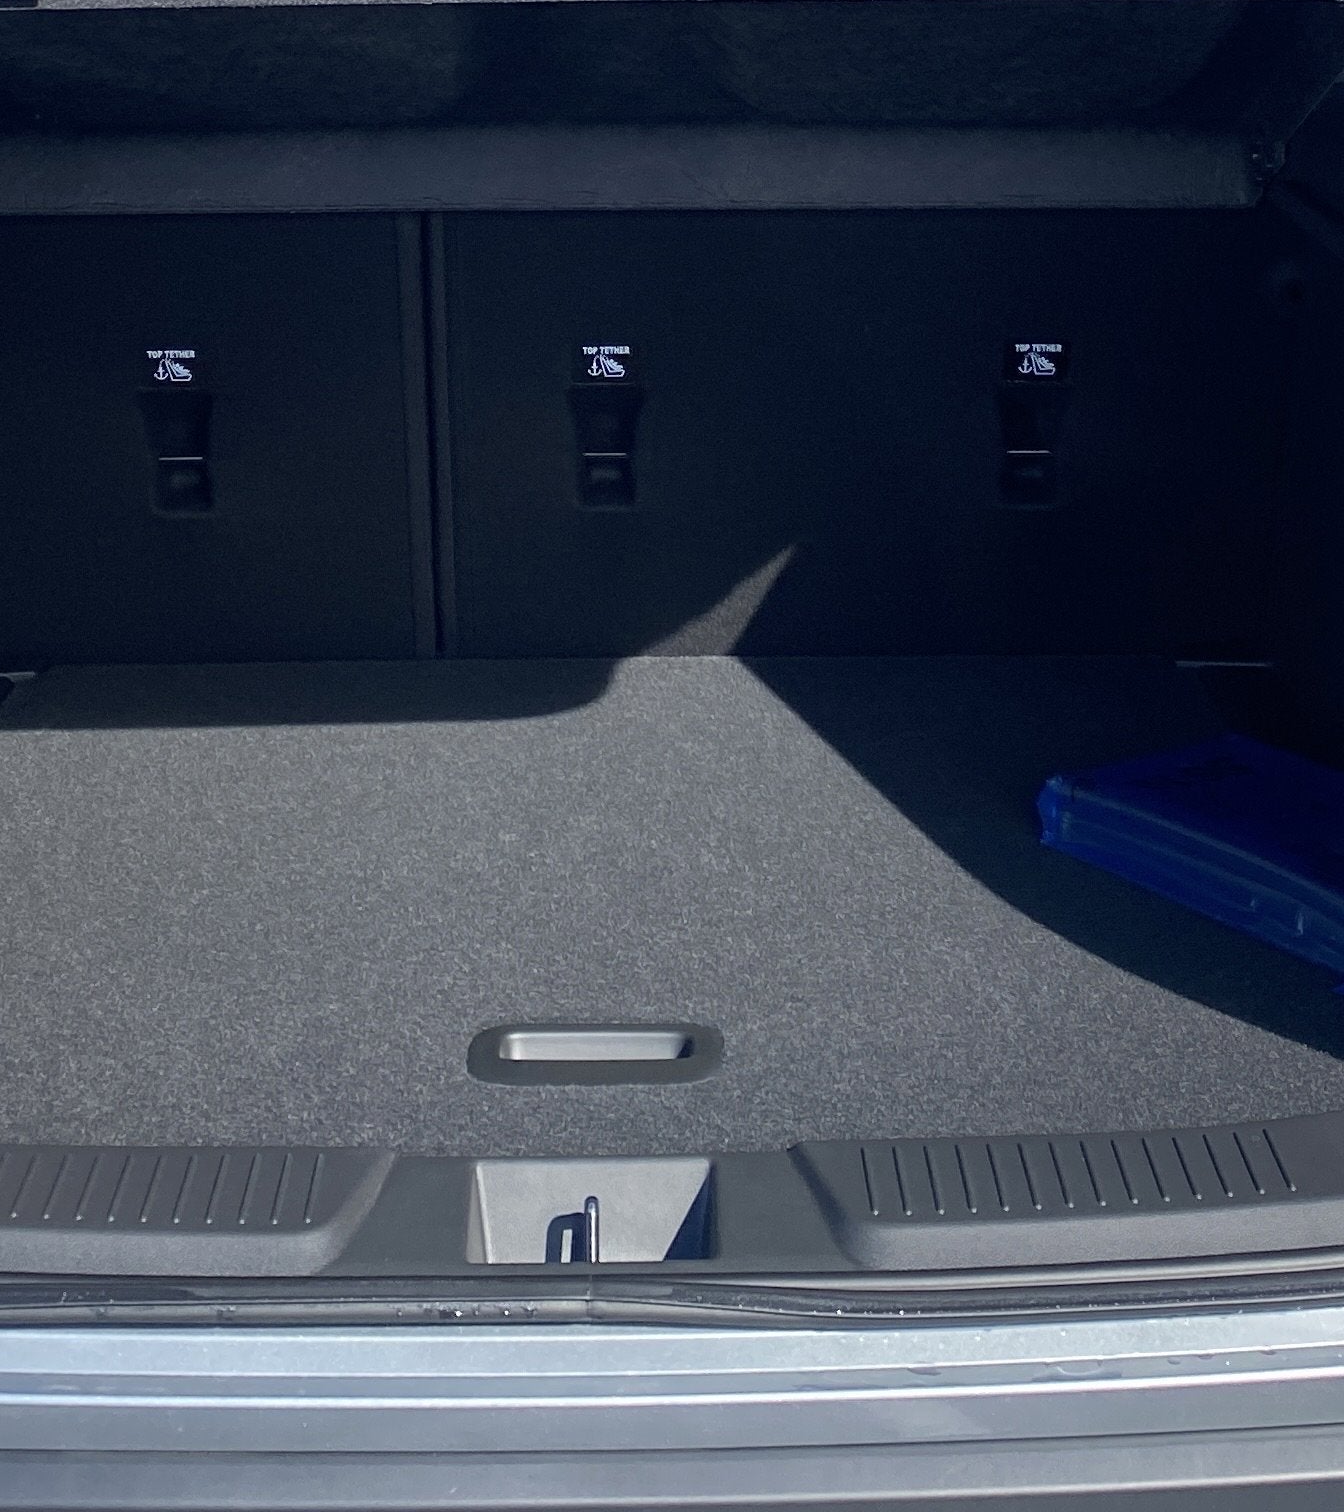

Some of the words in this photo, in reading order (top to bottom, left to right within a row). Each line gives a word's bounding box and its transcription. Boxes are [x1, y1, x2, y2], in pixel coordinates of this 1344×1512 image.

[582, 346, 598, 355] TOP
[599, 346, 630, 355] TETHER
[1014, 344, 1030, 352] TOP
[1031, 343, 1062, 352] TETHER
[146, 350, 163, 359] TOP
[164, 350, 196, 359] TETHER
